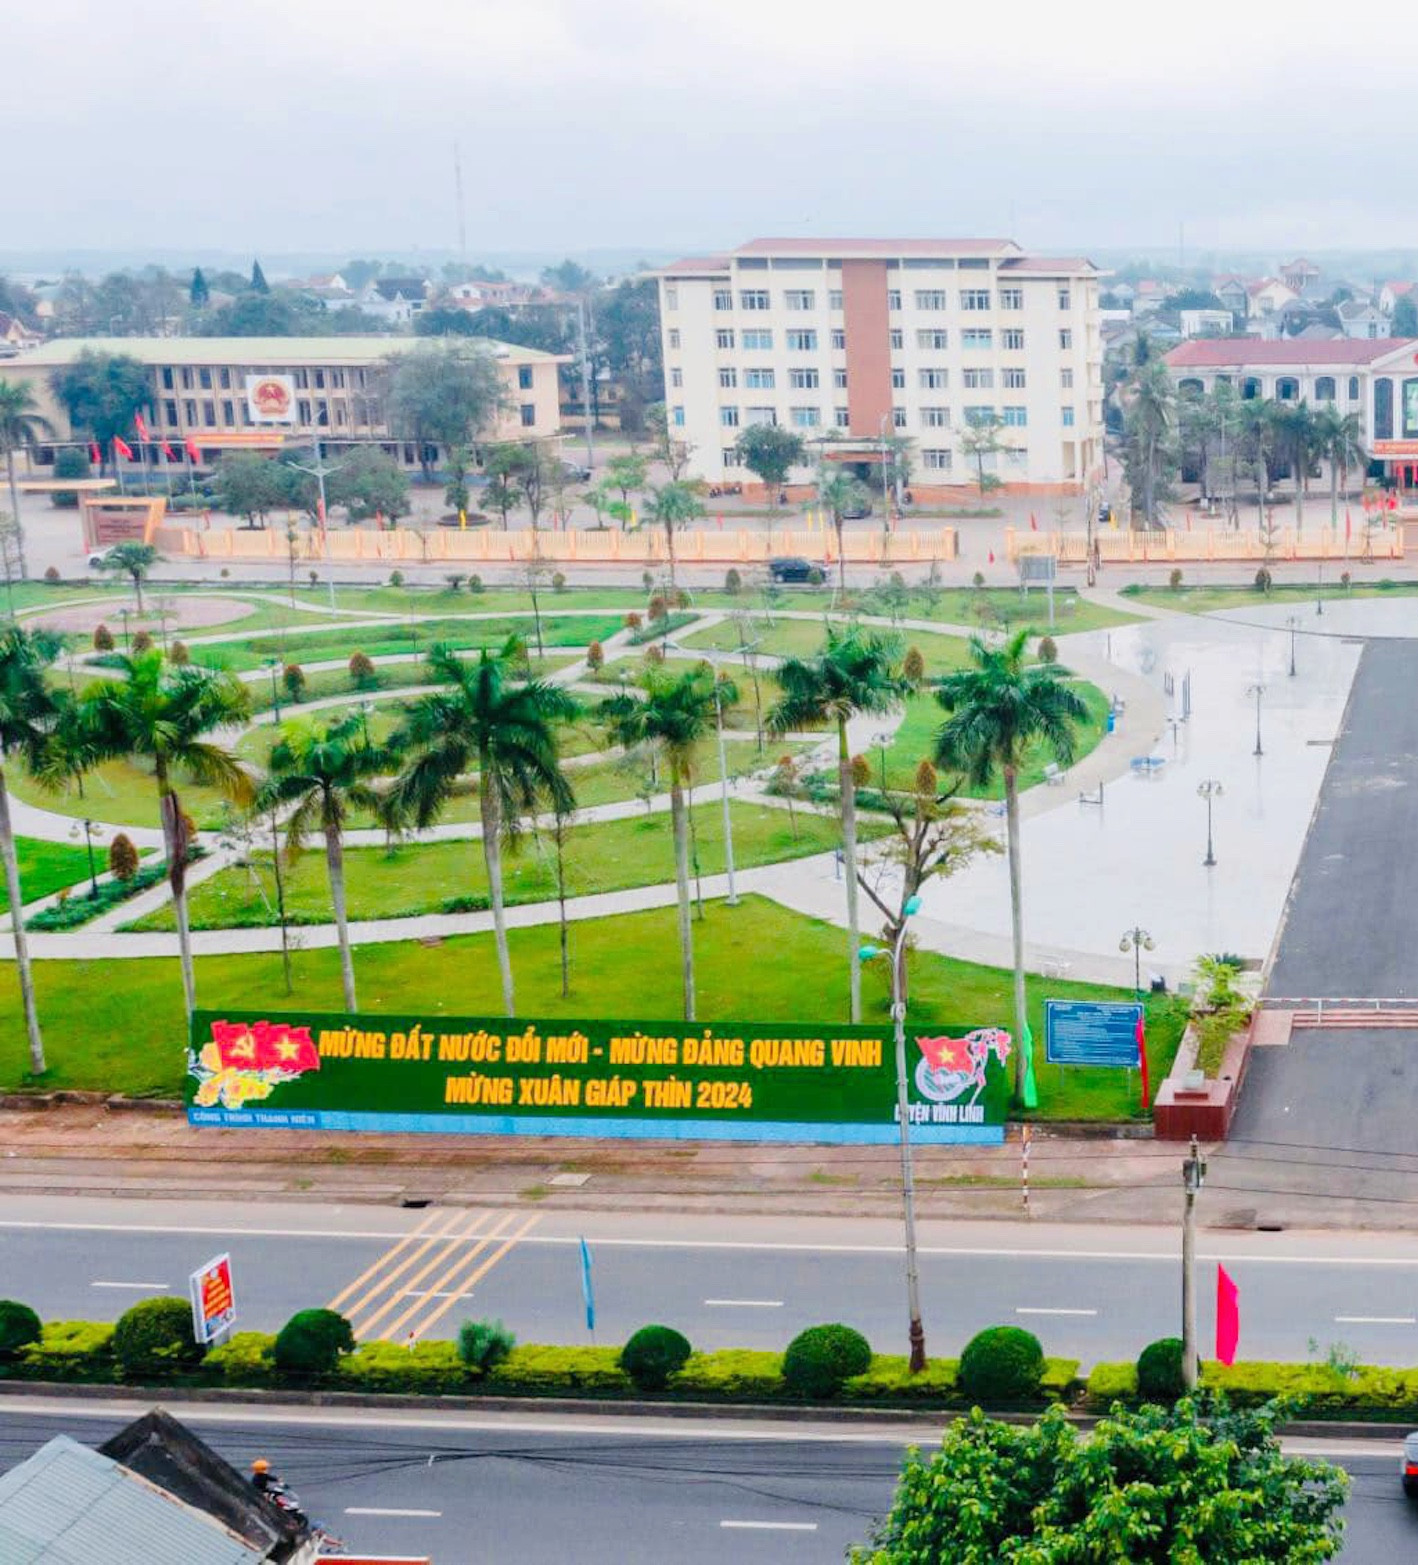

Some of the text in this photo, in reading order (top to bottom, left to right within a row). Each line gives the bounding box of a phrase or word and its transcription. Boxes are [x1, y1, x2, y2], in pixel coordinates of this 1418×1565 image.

[319, 1024, 882, 1069] MỪNG ĐẤT NƯỚC ĐỔI MỚI - MỪNG ĐẢNG QUANG VINH
[445, 1071, 752, 1108] MỪNG XUÂN GIÁP THÌN 2024
[959, 1105, 984, 1122] LINH
